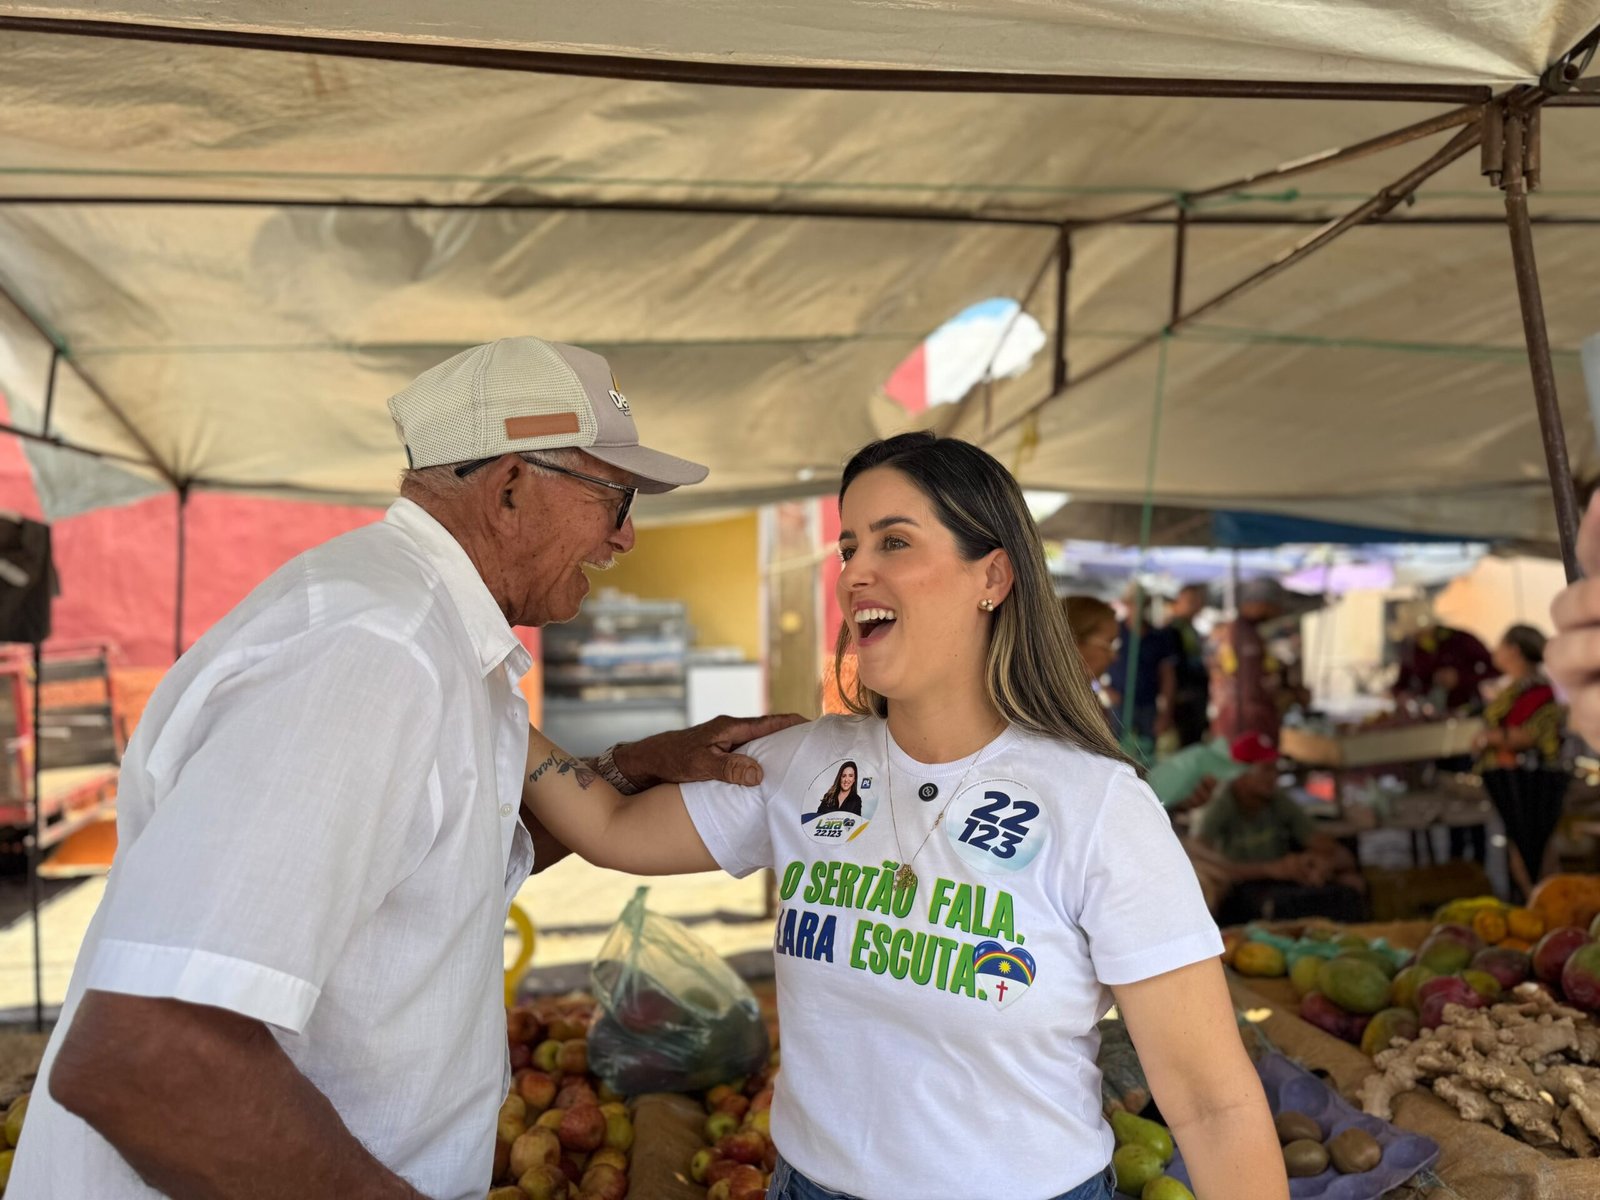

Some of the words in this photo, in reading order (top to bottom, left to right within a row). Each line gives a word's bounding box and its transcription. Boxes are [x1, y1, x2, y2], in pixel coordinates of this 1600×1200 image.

[816, 819, 843, 829] Lara
[970, 791, 1039, 836] 22
[958, 817, 1024, 859] 123
[780, 861, 805, 900] O
[803, 860, 918, 918] SERTÃO
[928, 877, 1025, 945] FALA.
[776, 908, 837, 963] LARA
[850, 919, 988, 1000] ESCUTA.
